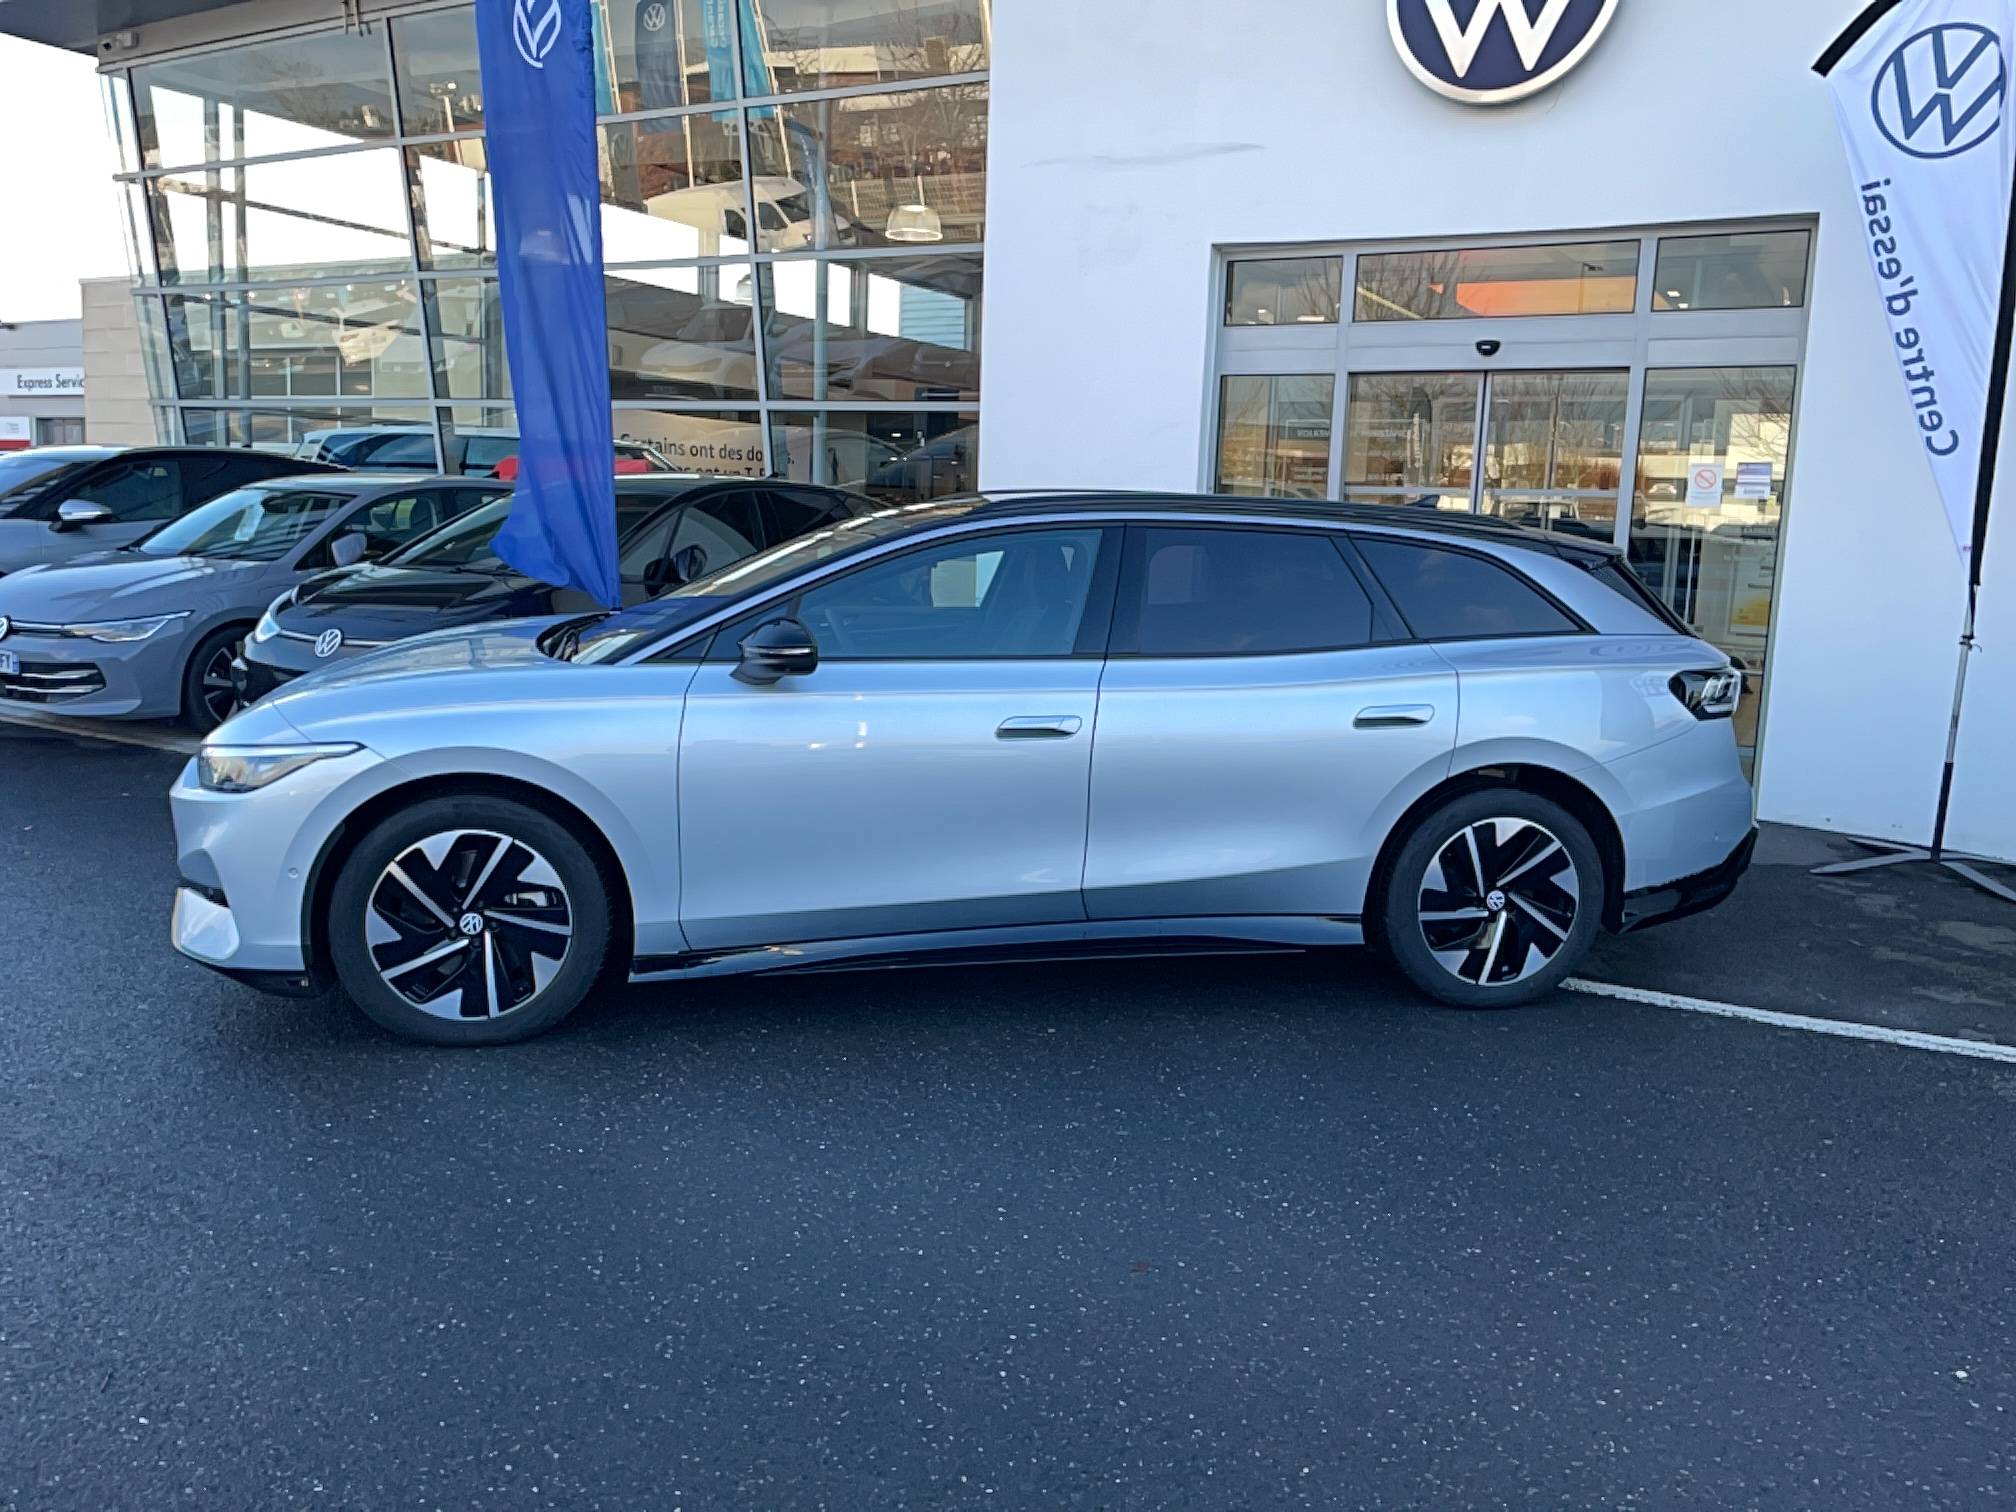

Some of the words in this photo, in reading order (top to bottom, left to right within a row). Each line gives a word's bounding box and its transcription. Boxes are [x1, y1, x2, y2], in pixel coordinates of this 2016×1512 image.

[16, 374, 53, 392] Express
[690, 444, 715, 460] ont
[719, 444, 743, 461] des
